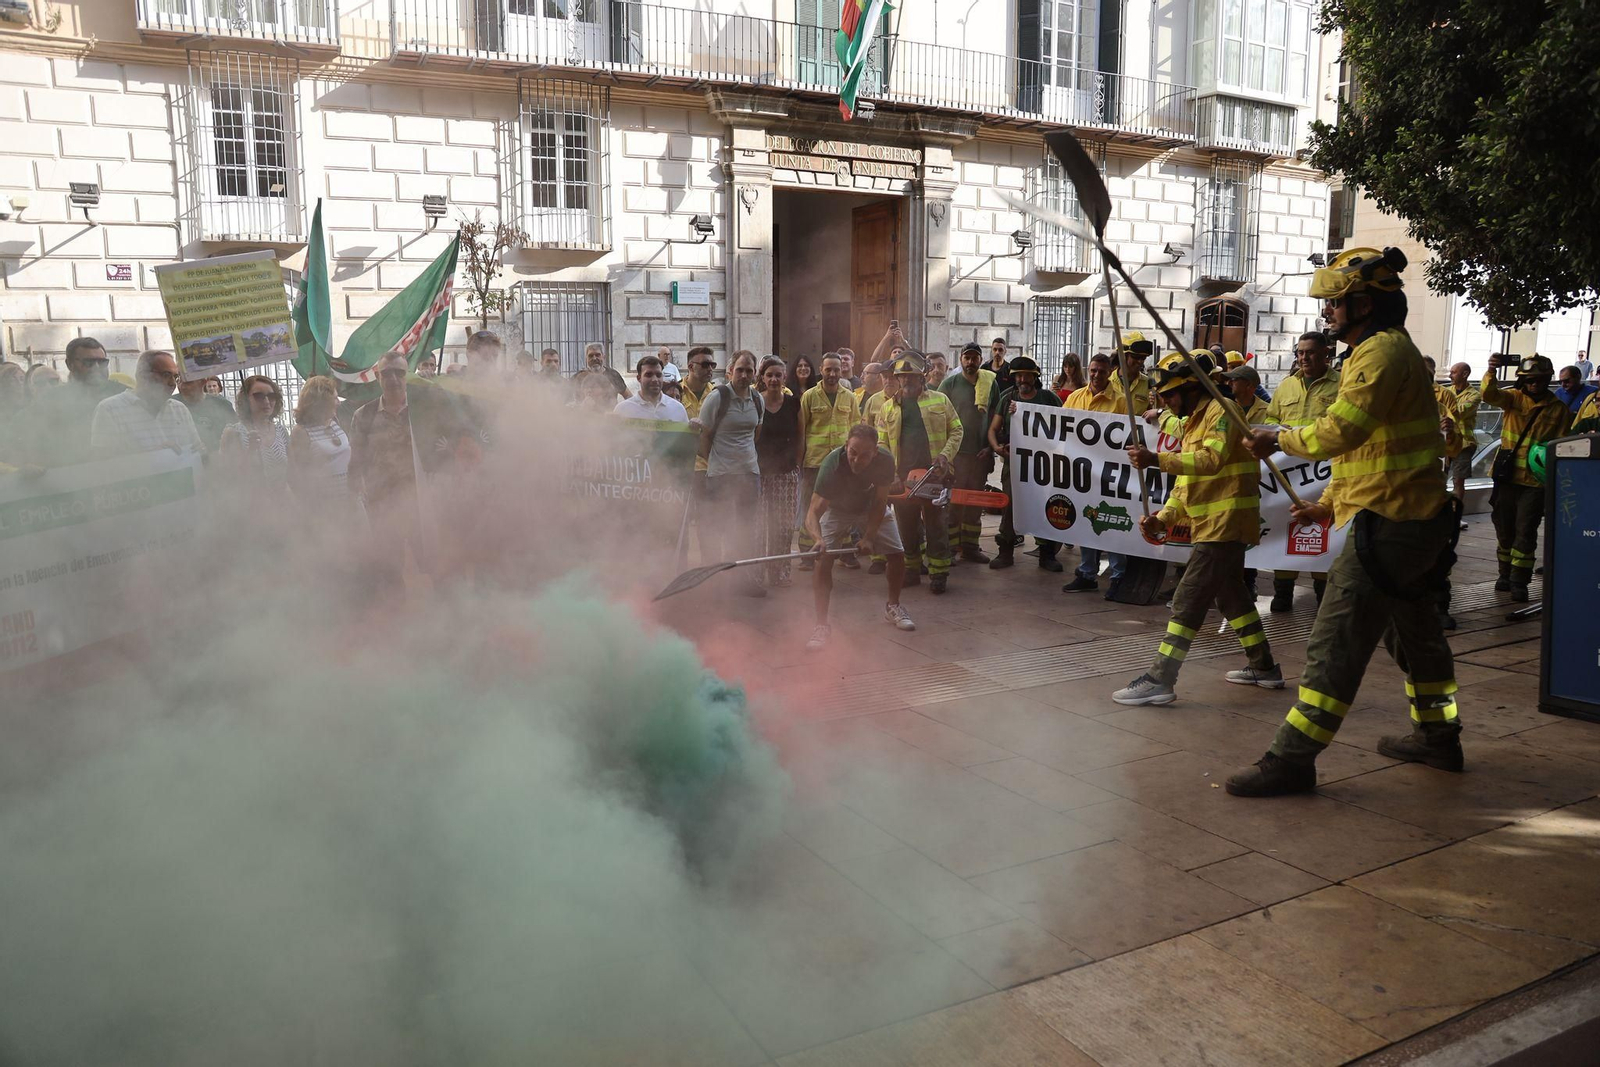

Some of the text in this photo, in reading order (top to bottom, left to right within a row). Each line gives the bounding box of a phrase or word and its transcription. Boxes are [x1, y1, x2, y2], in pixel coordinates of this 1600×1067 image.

[766, 134, 922, 163] DELEGACION DEL GOBIERNO
[771, 153, 916, 178] JUNTA DE ANDALUCIA
[1022, 410, 1147, 450] INFOCA
[1016, 447, 1092, 493] TODO
[1100, 461, 1132, 500] EL
[584, 481, 685, 504] INTEGRACIÓN
[18, 500, 85, 526] EMPLEO
[1052, 506, 1069, 516] CGT
[1296, 537, 1322, 545] CCOO
[26, 561, 68, 583] Agencia
[70, 559, 84, 573] de
